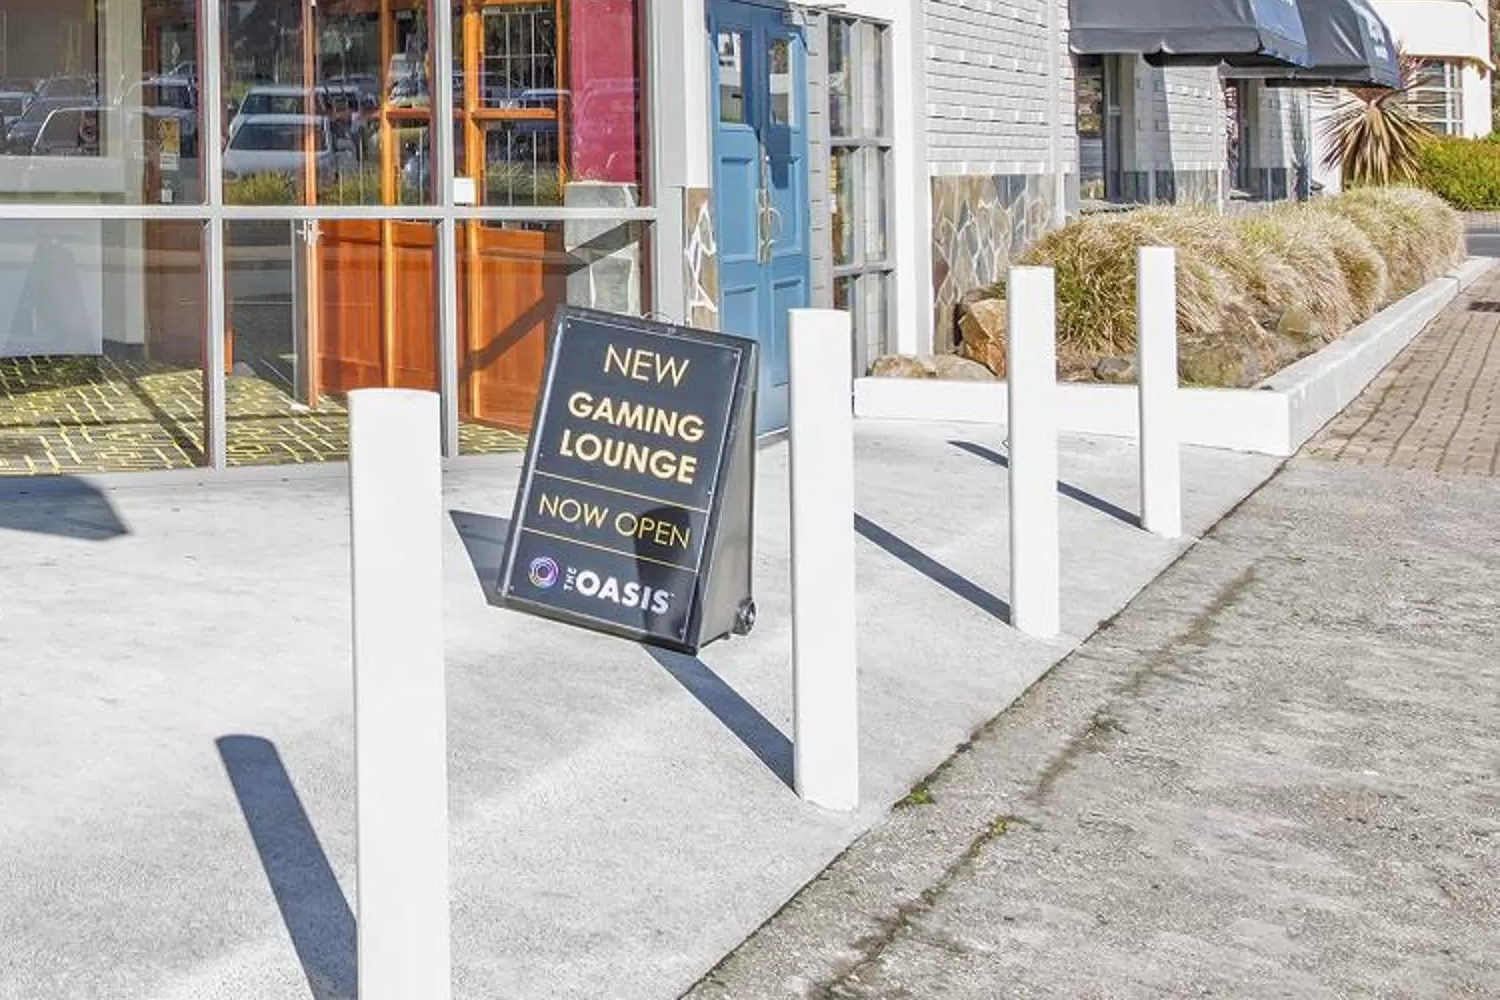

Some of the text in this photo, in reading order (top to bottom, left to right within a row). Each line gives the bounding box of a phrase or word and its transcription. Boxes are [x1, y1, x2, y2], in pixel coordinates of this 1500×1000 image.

[603, 344, 690, 388] NEW
[567, 391, 705, 443] GAMING
[559, 429, 698, 485] LOUNGE
[538, 493, 692, 550] NOW OPEN
[563, 567, 670, 616] THE OASIS
